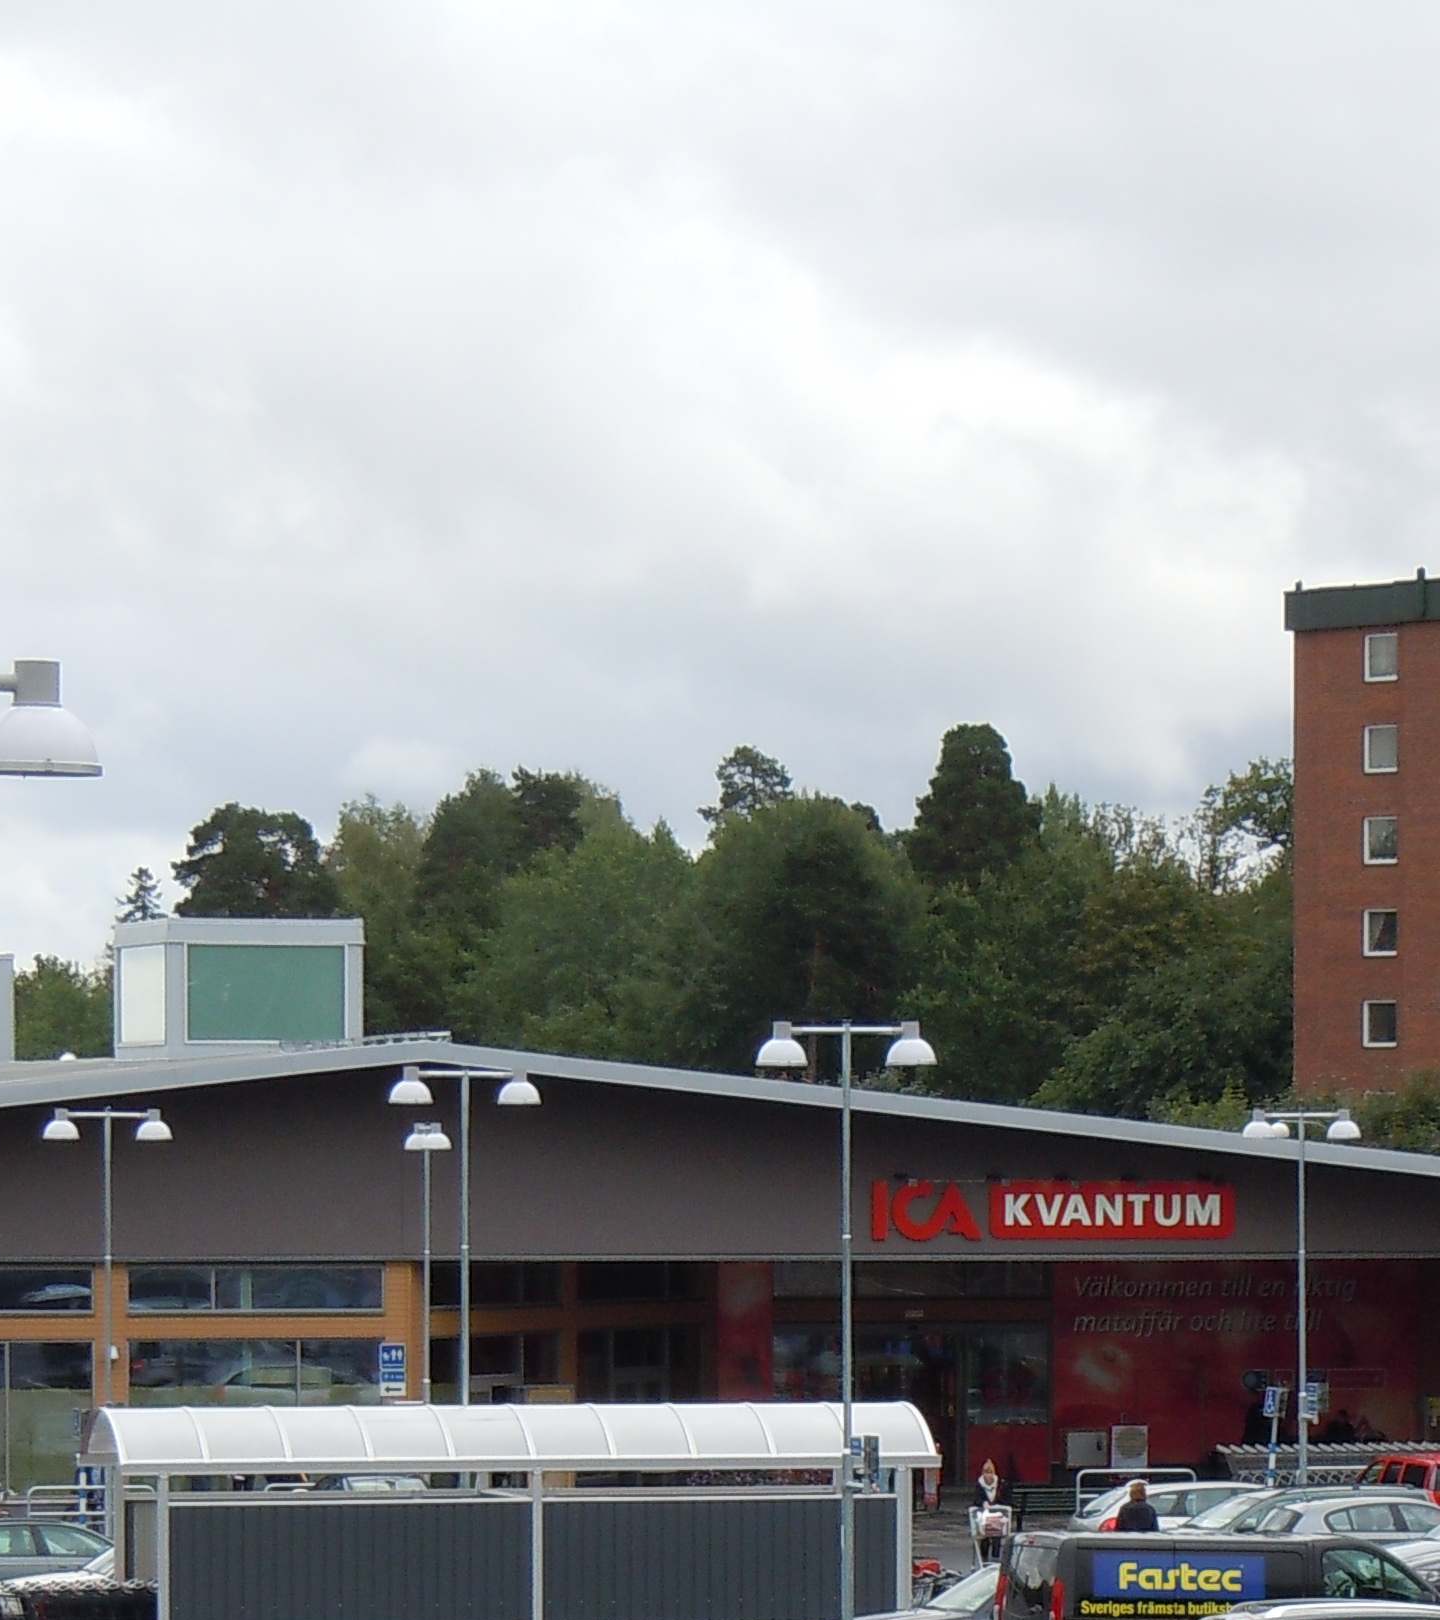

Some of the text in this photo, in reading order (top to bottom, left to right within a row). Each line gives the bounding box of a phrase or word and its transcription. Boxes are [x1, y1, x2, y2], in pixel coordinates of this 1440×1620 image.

[872, 1180, 1221, 1241] ICA KVANTUM
[1074, 1276, 1211, 1298] Välkommen
[1119, 1562, 1242, 1592] Fastec
[1081, 1600, 1135, 1617] Sveriges
[1137, 1601, 1185, 1616] främsta
